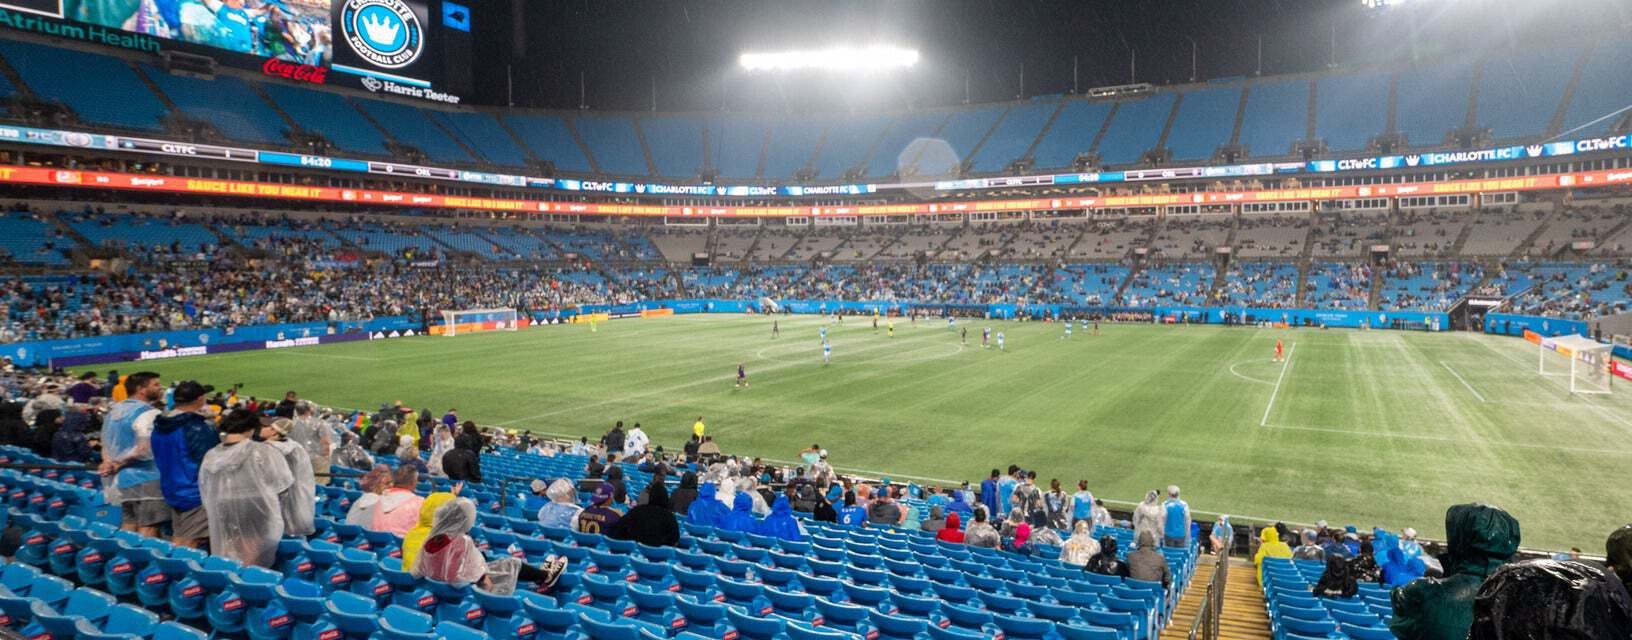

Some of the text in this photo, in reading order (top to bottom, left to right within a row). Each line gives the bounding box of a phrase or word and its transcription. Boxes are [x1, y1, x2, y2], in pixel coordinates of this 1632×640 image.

[0, 10, 161, 52] Atrium Health
[351, 35, 414, 65] FOOTBALL CLUB
[384, 80, 460, 104] Harris Teeter
[161, 143, 197, 155] CLTFC
[1434, 147, 1512, 163] CHARLOTTE FC
[300, 155, 332, 168] 84:20
[187, 180, 321, 198] SAUCE LIKE YOU MEAN IT
[655, 185, 698, 194] CHARLOTTE
[843, 513, 851, 524] 6
